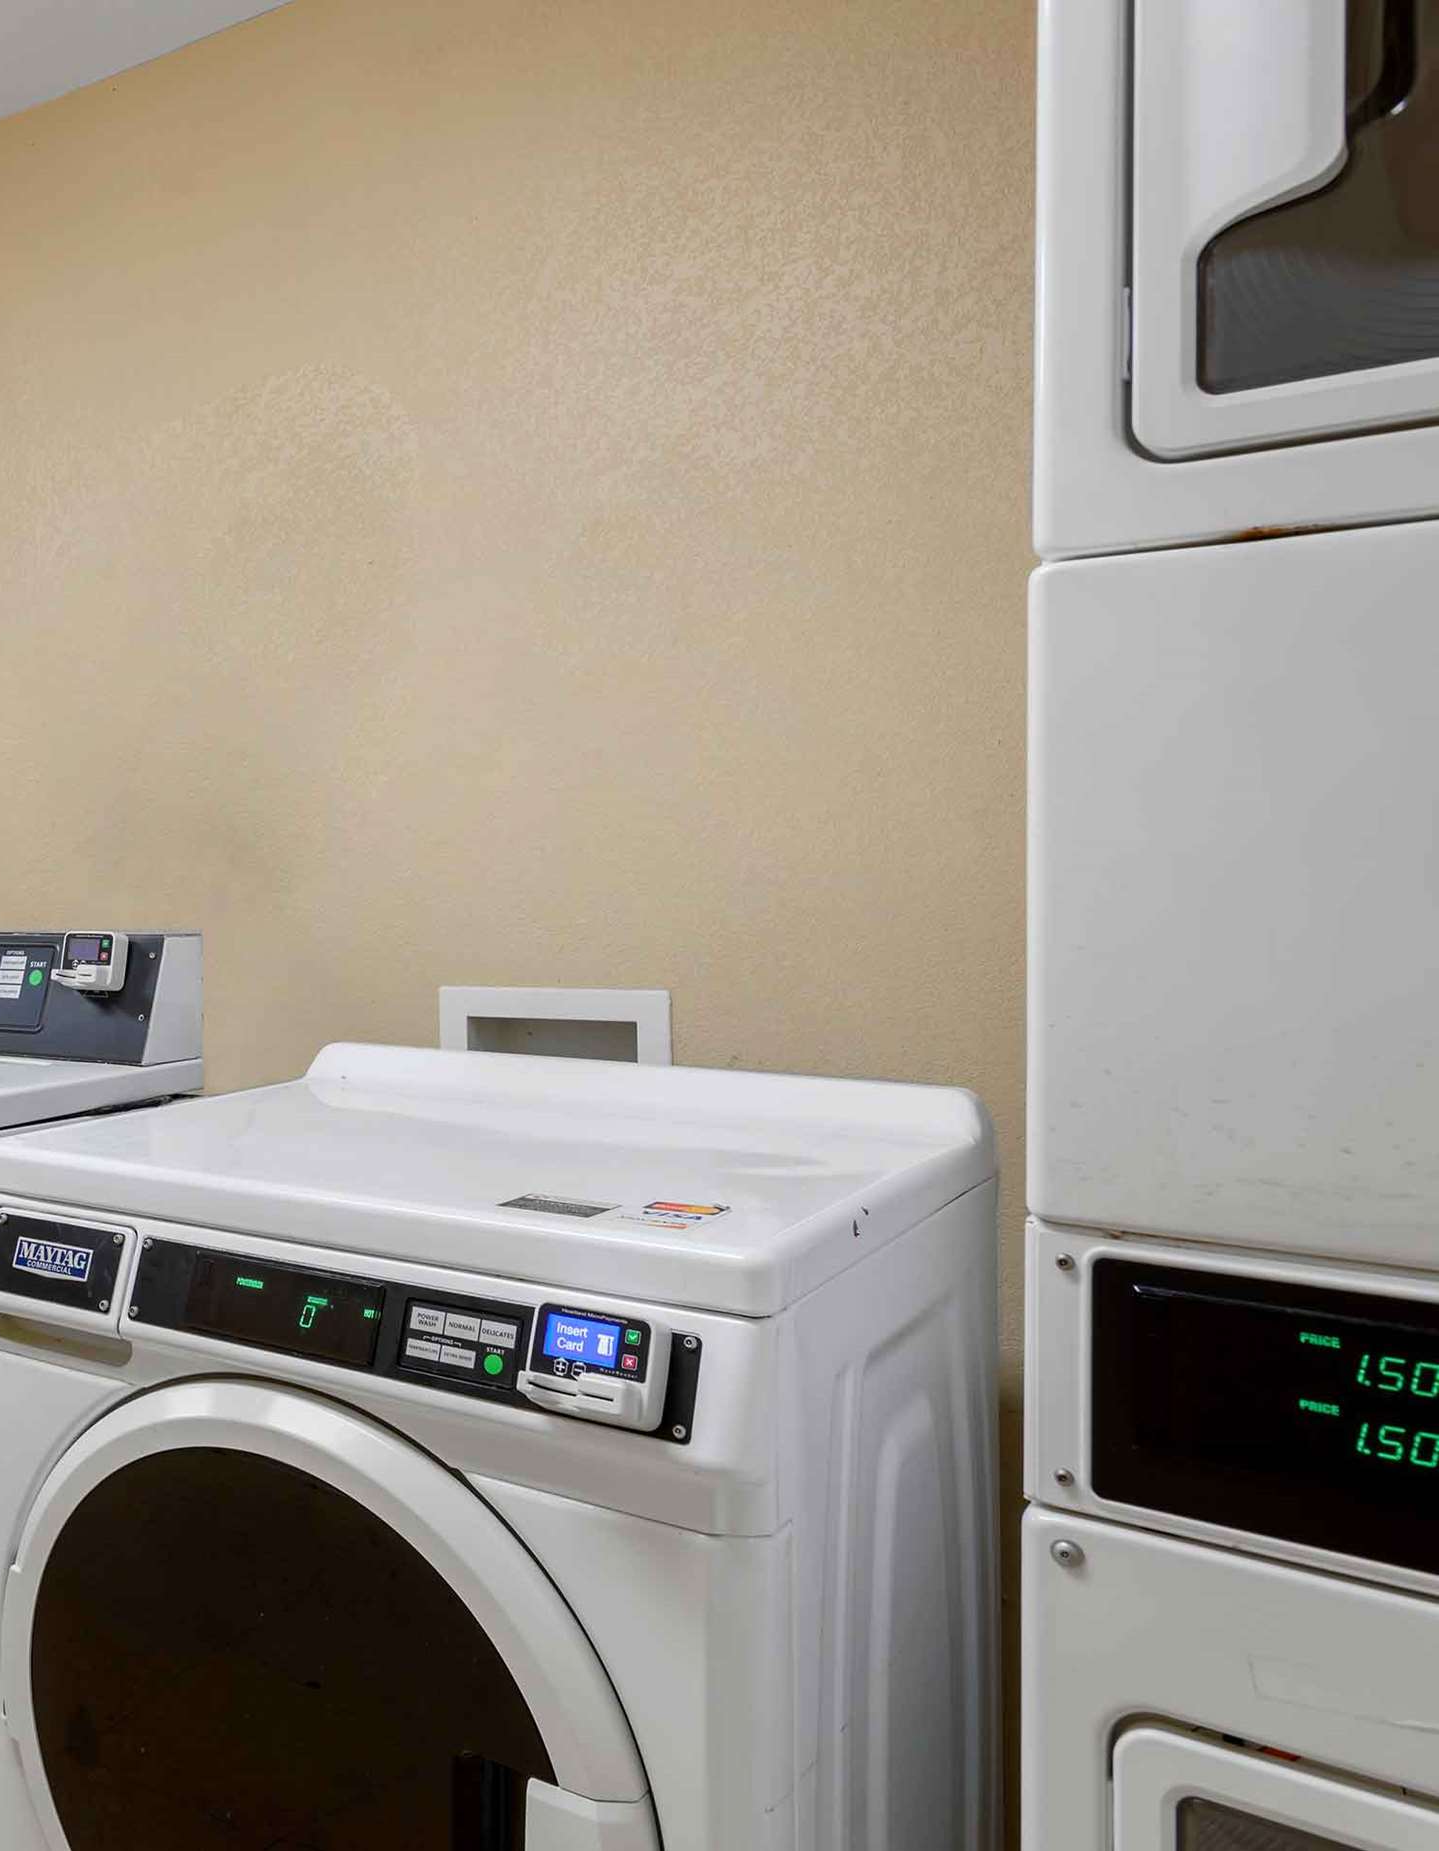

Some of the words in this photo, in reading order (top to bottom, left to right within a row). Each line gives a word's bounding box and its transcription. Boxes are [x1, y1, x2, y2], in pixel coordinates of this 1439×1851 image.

[18, 1241, 87, 1270] MAYTAG
[26, 1259, 72, 1275] COMMERCIAL
[417, 1312, 439, 1321] POWER
[417, 1319, 437, 1327] WASH
[448, 1321, 476, 1333] NORMAL
[481, 1327, 514, 1340] DELICATES
[556, 1322, 588, 1338] Insert
[556, 1337, 584, 1352] Card
[1299, 1331, 1341, 1349] PRICE
[486, 1346, 505, 1355] START
[1299, 1398, 1340, 1416] PRICE
